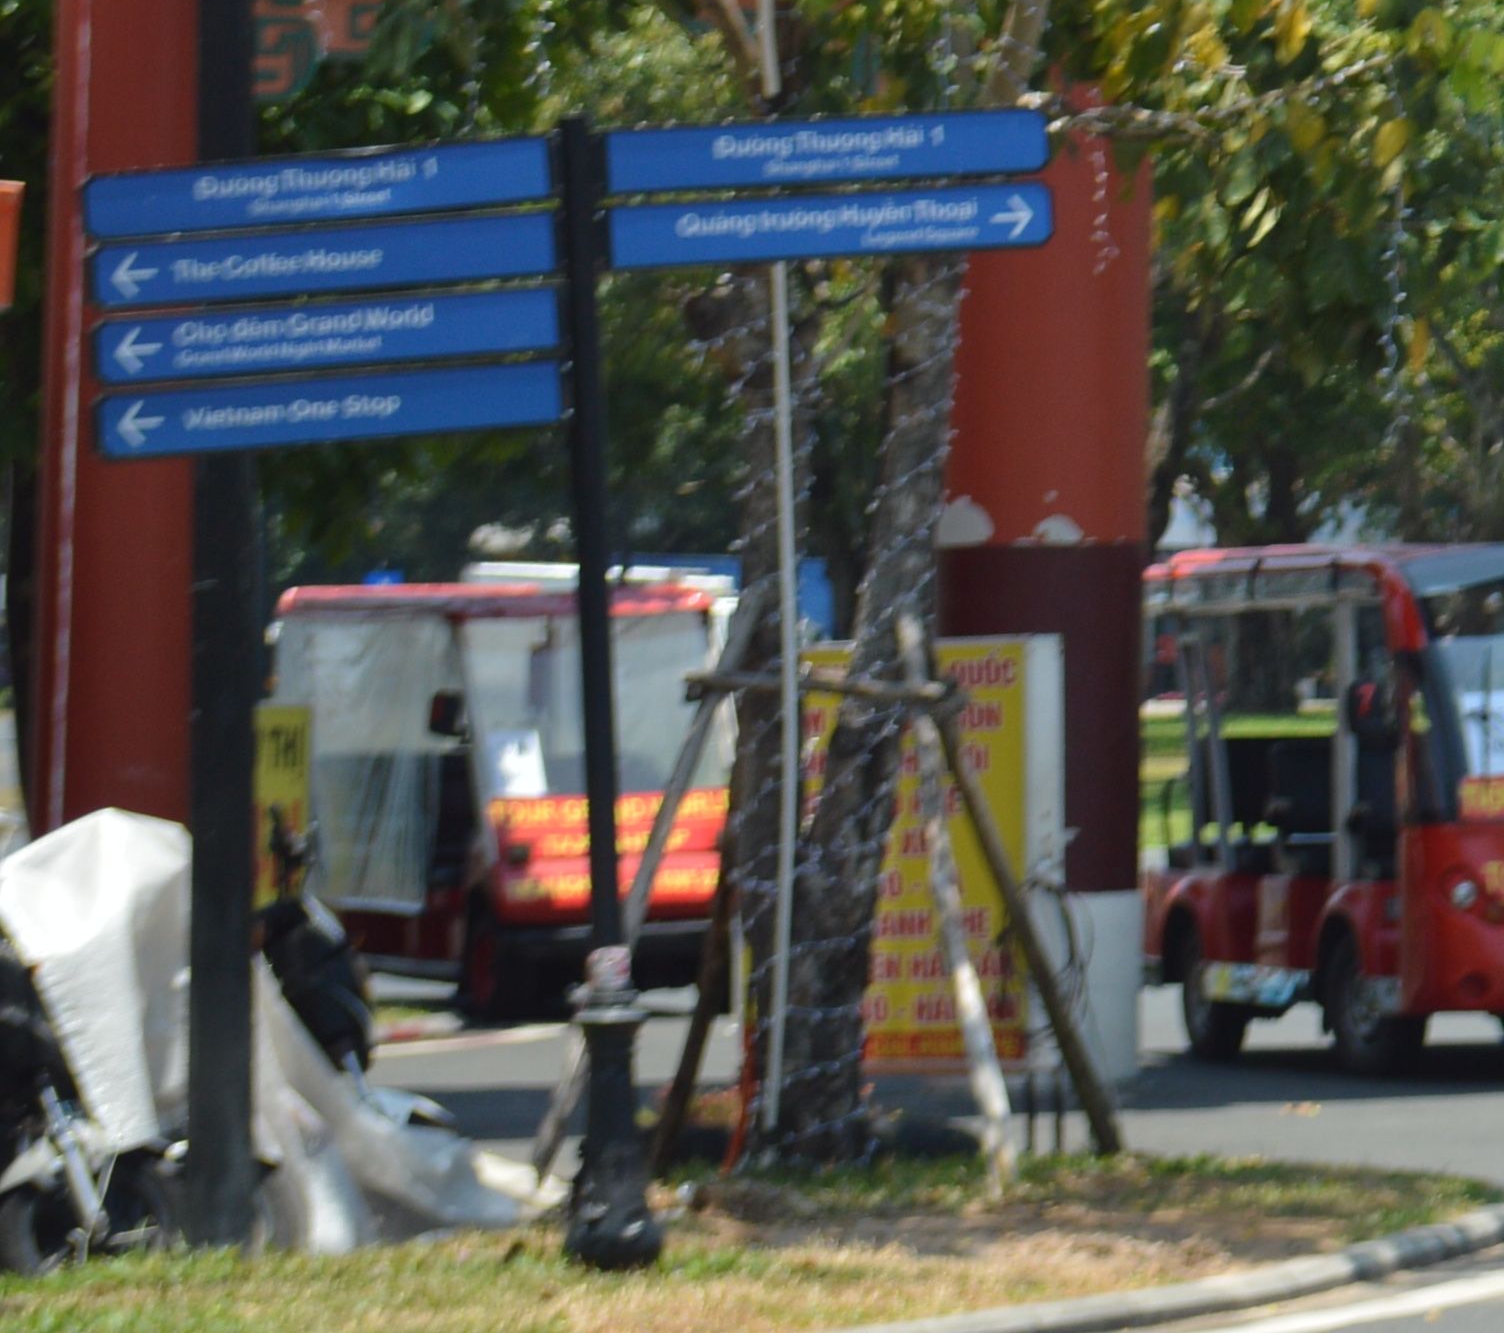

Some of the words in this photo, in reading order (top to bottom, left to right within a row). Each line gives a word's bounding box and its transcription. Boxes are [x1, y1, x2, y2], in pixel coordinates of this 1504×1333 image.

[171, 257, 221, 284] The
[222, 251, 304, 278] Coffee
[306, 245, 384, 271] House
[289, 311, 364, 337] Grand
[367, 302, 435, 328] World
[182, 404, 285, 432] Vietnam
[287, 397, 338, 423] One
[341, 393, 402, 420] Stop
